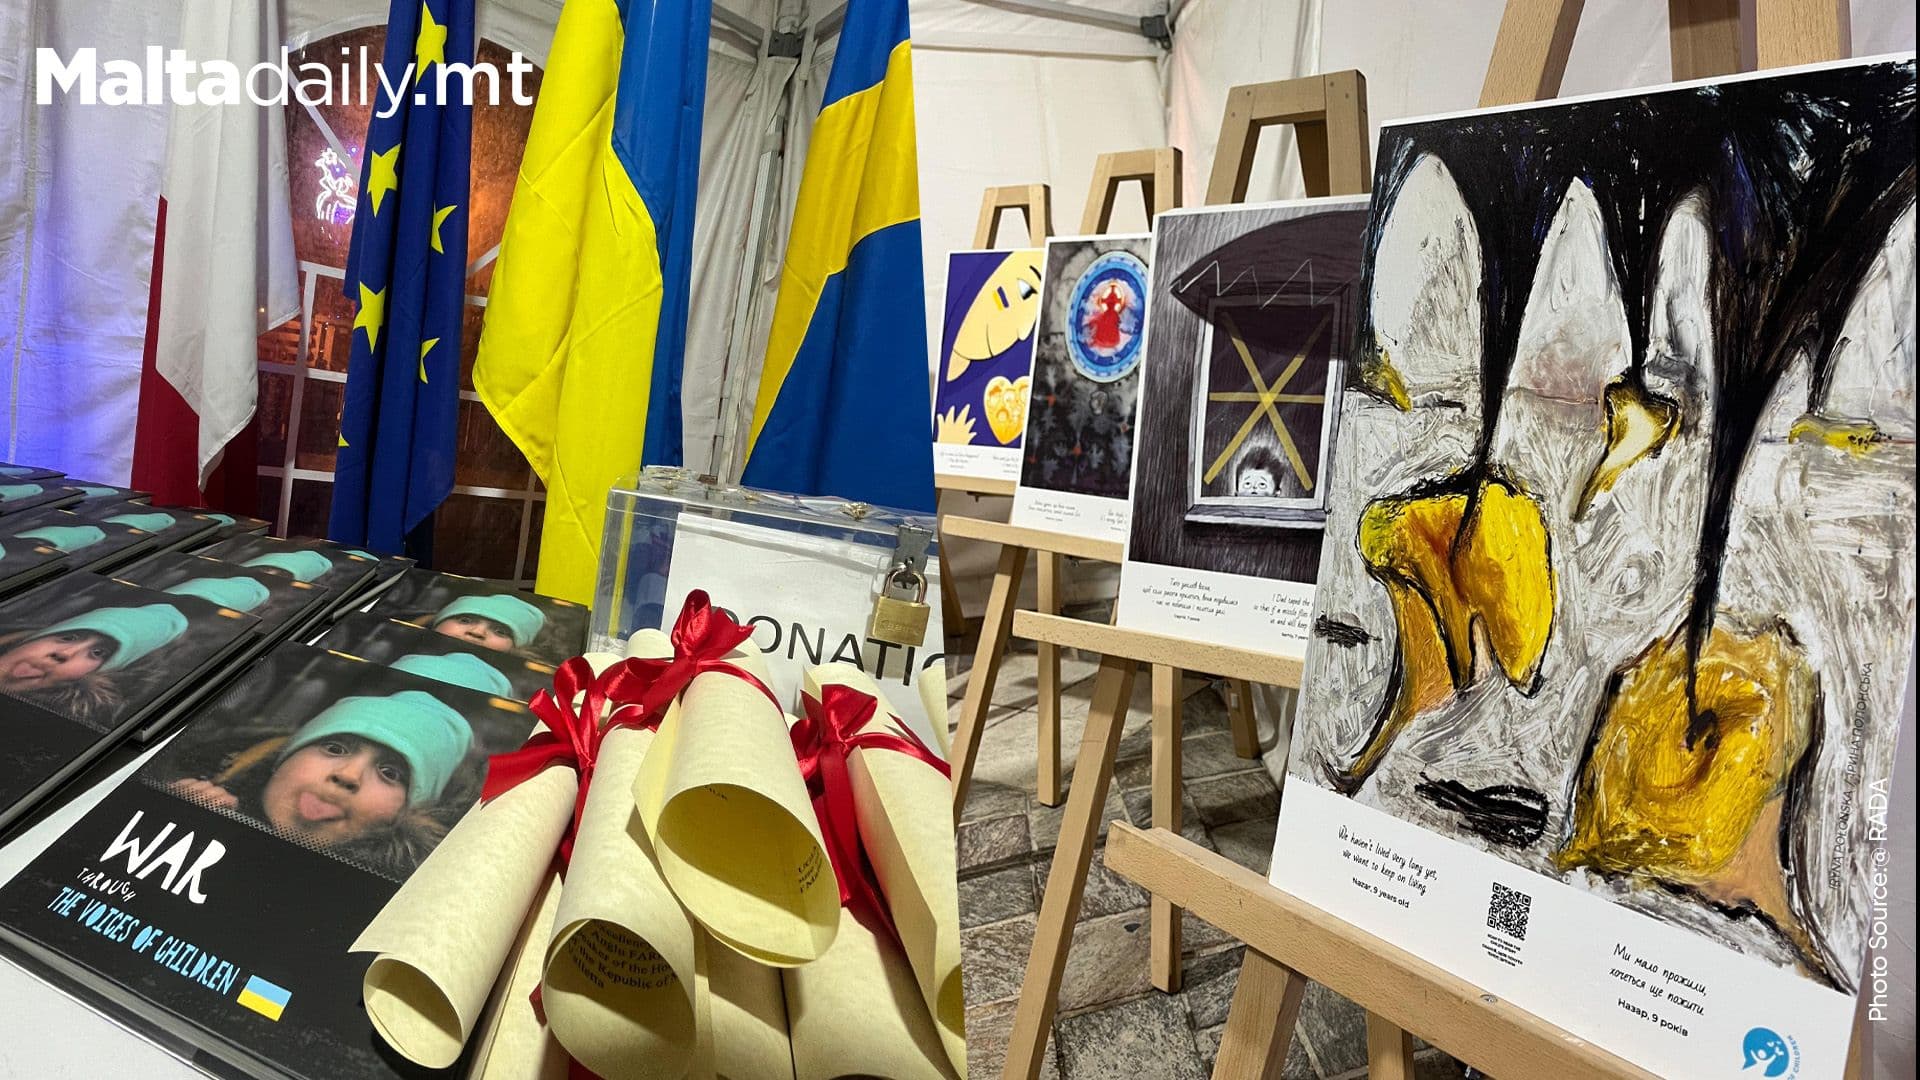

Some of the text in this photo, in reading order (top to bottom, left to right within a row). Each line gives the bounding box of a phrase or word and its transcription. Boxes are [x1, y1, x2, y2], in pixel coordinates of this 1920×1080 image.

[100, 810, 227, 904] WAR
[1338, 825, 1349, 841] We
[1350, 833, 1373, 851] haven't
[1375, 843, 1391, 858] lived
[1392, 853, 1406, 869] very
[1408, 858, 1423, 876] long
[1342, 850, 1427, 897] we want to keep on living
[77, 867, 137, 902] THROUGH
[1352, 877, 1410, 909] Nazar, 9 years old
[47, 886, 241, 995] THE VOICES OF CHILDREN
[1609, 968, 1647, 989] хочеться
[1649, 984, 1665, 998] ще
[1613, 943, 1707, 997] Ми мало прожили,
[1618, 998, 1689, 1037] Назар, 9 років
